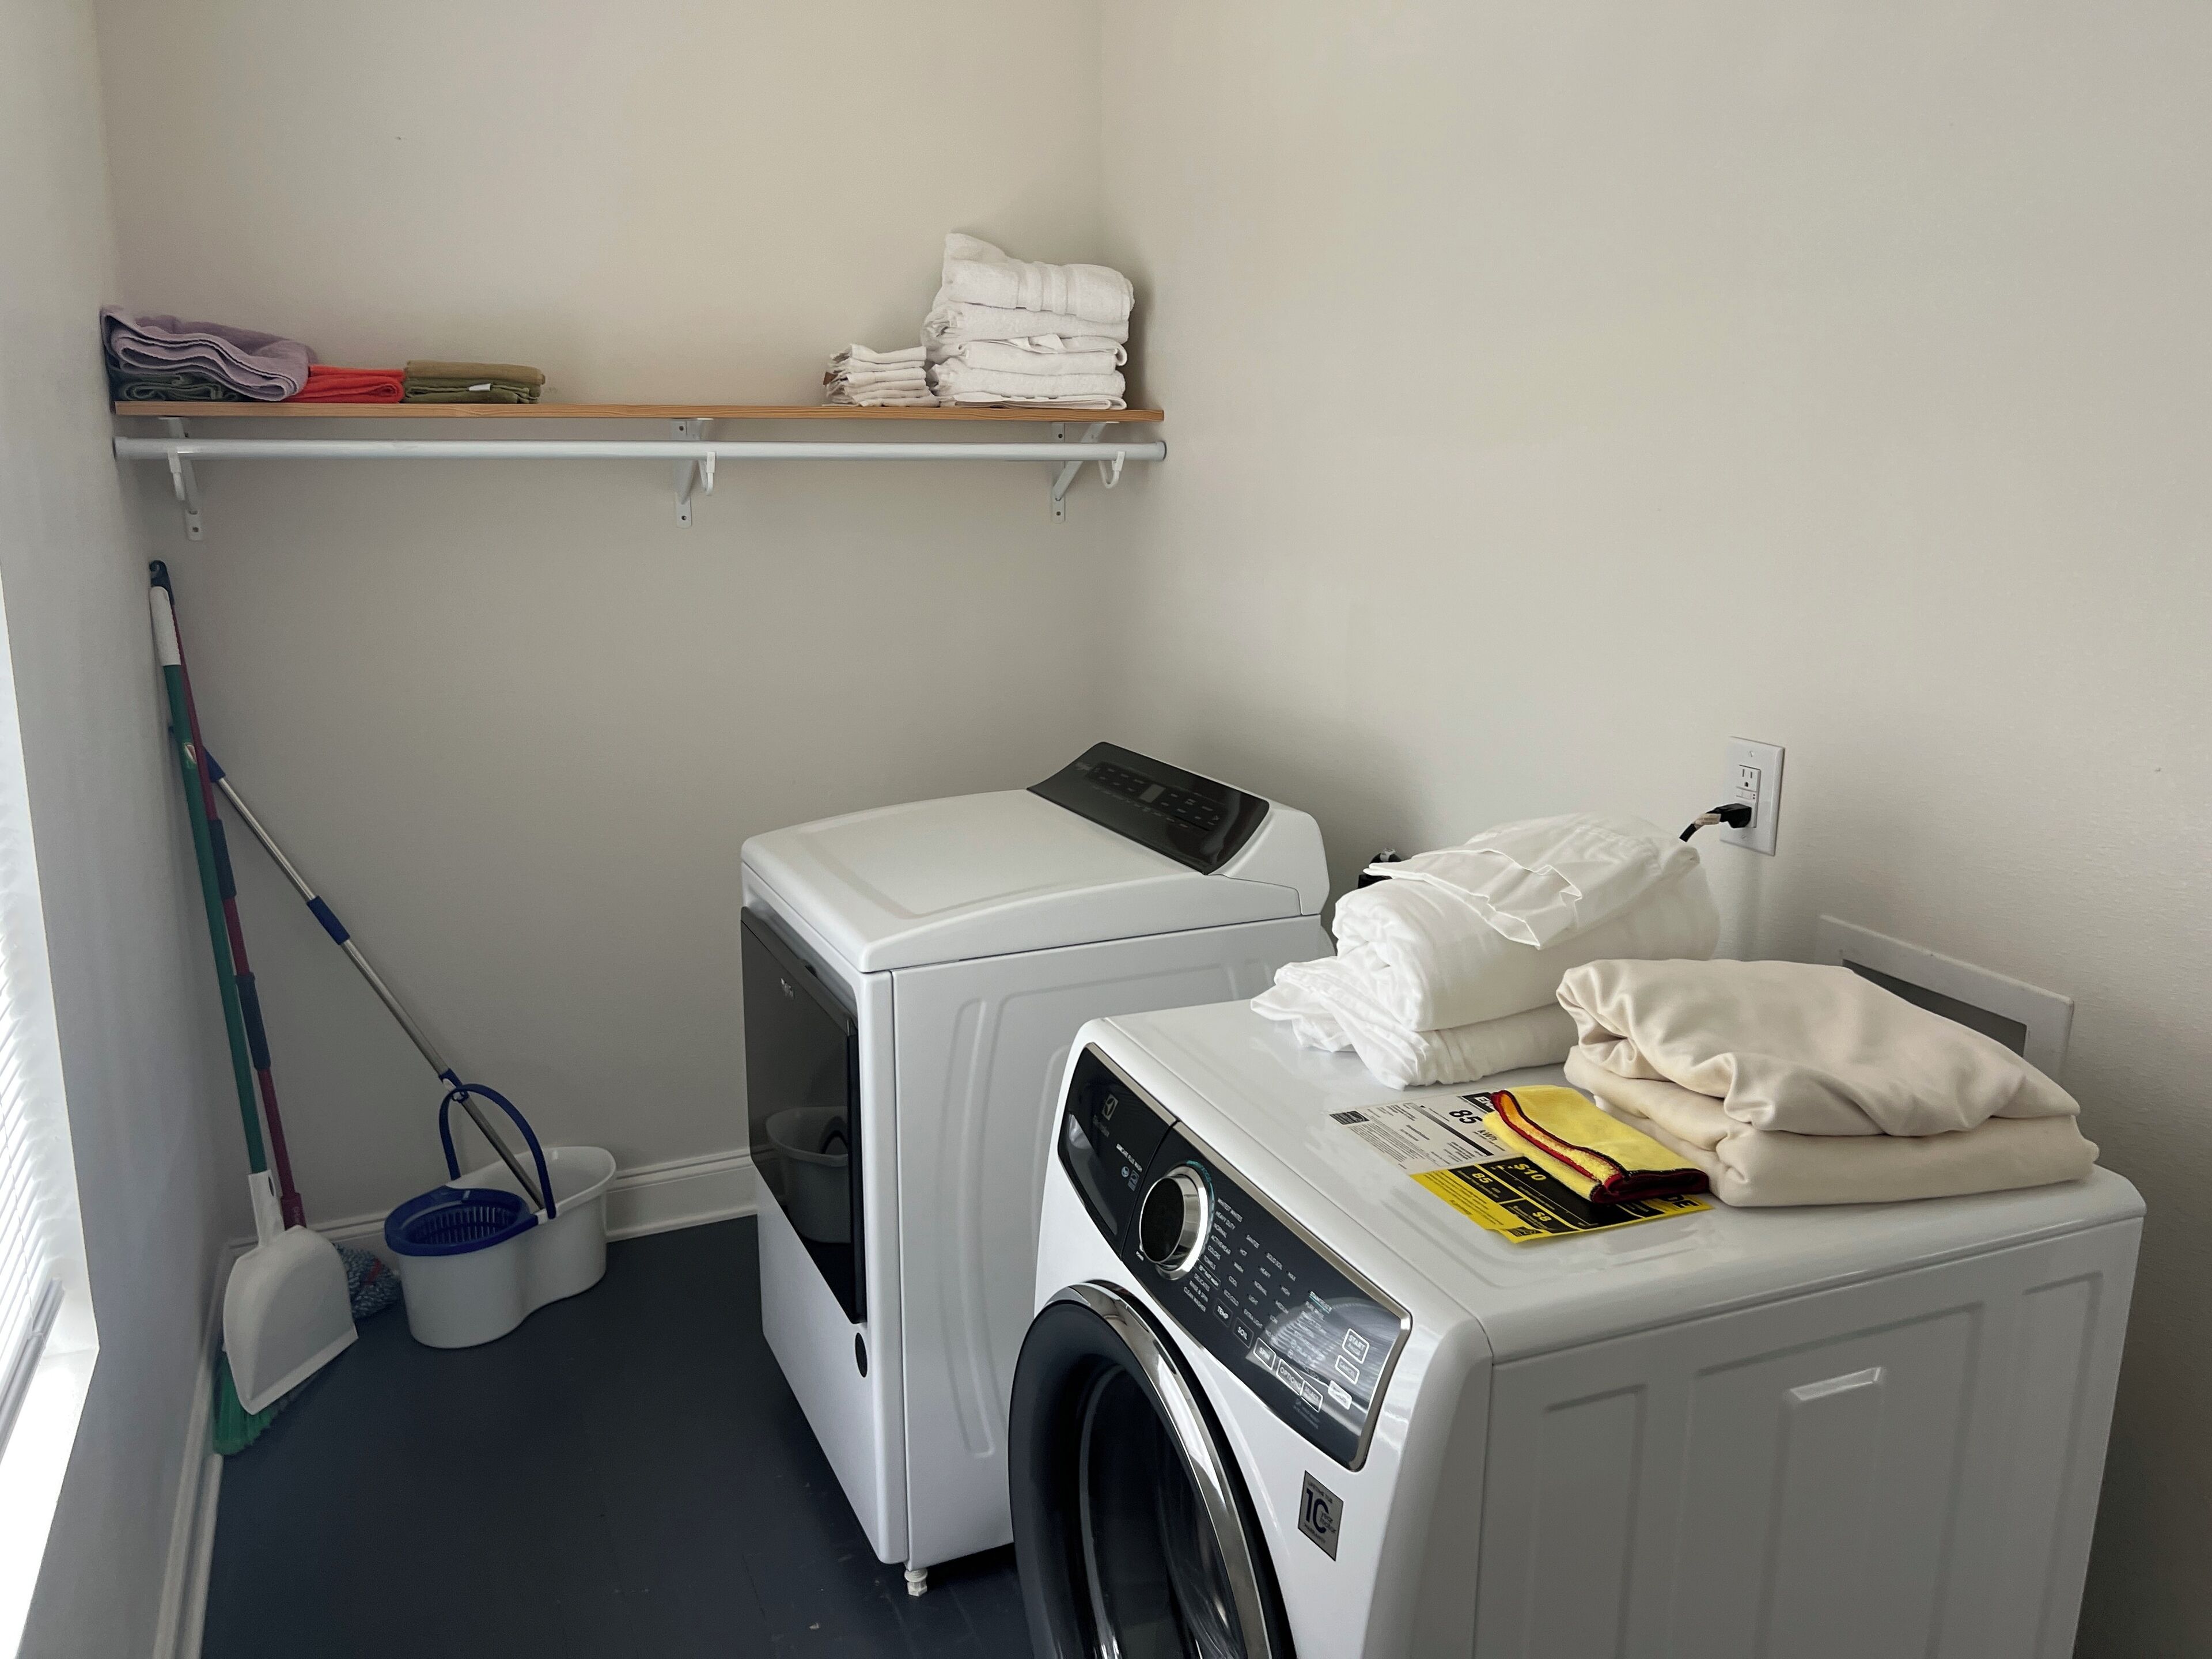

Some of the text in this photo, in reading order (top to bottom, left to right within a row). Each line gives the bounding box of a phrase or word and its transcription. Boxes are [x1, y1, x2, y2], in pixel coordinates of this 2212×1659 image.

[1449, 1109, 1483, 1124] 85
[1478, 1129, 1499, 1142] kWh
[1471, 1172, 1494, 1184] 85
[1513, 1163, 1547, 1181] $10
[1215, 1211, 1236, 1230] HEAVY DUTY
[1532, 1211, 1552, 1222] $8
[1213, 1223, 1228, 1238] NORMAL
[1260, 1267, 1271, 1278] HEAVY
[1194, 1273, 1210, 1291] DELICATES
[1228, 1275, 1237, 1287] COOL
[1217, 1305, 1229, 1319] TEMP
[1237, 1326, 1248, 1340] SOIL
[1348, 1335, 1365, 1351] START
[1259, 1346, 1270, 1361] SPIN
[1279, 1366, 1302, 1389] OPTIONS
